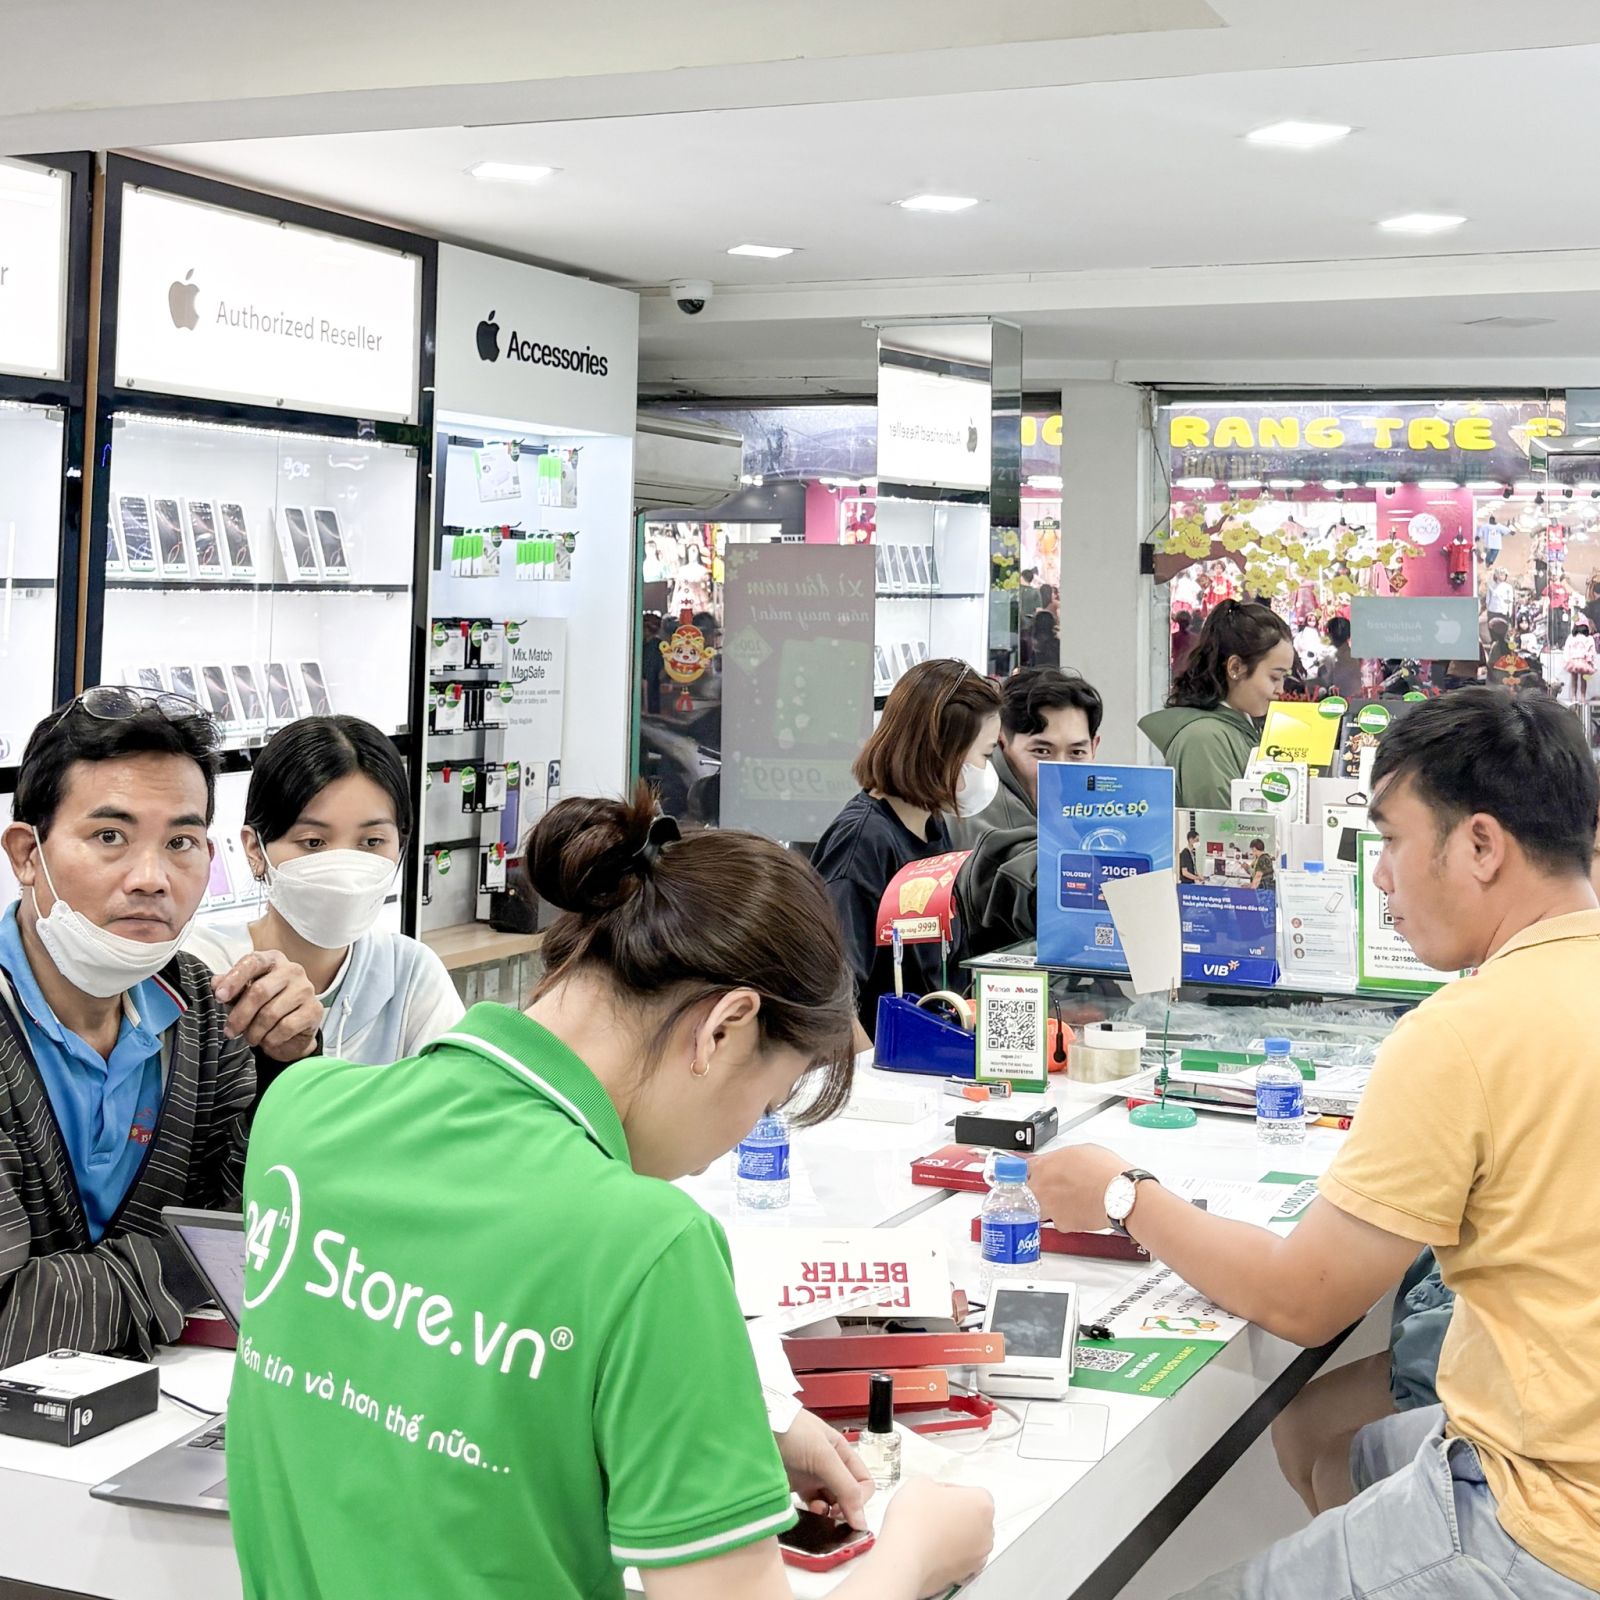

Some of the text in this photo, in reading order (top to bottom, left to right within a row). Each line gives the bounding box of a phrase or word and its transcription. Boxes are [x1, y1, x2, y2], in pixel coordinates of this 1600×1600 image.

[216, 301, 383, 351] Authorized Reseller
[506, 330, 608, 376] Accessories
[528, 648, 553, 662] Match
[511, 665, 546, 681] MagSafe
[1062, 800, 1149, 818] SIÊU TỐC ĐỘ
[1102, 866, 1137, 877] 210GB
[918, 922, 937, 932] 9999
[1203, 964, 1229, 976] VIB
[801, 1262, 908, 1283] BETTER
[264, 1354, 294, 1386] tin
[305, 1371, 335, 1400] và
[341, 1378, 379, 1421] hơn
[385, 1404, 424, 1442] thế
